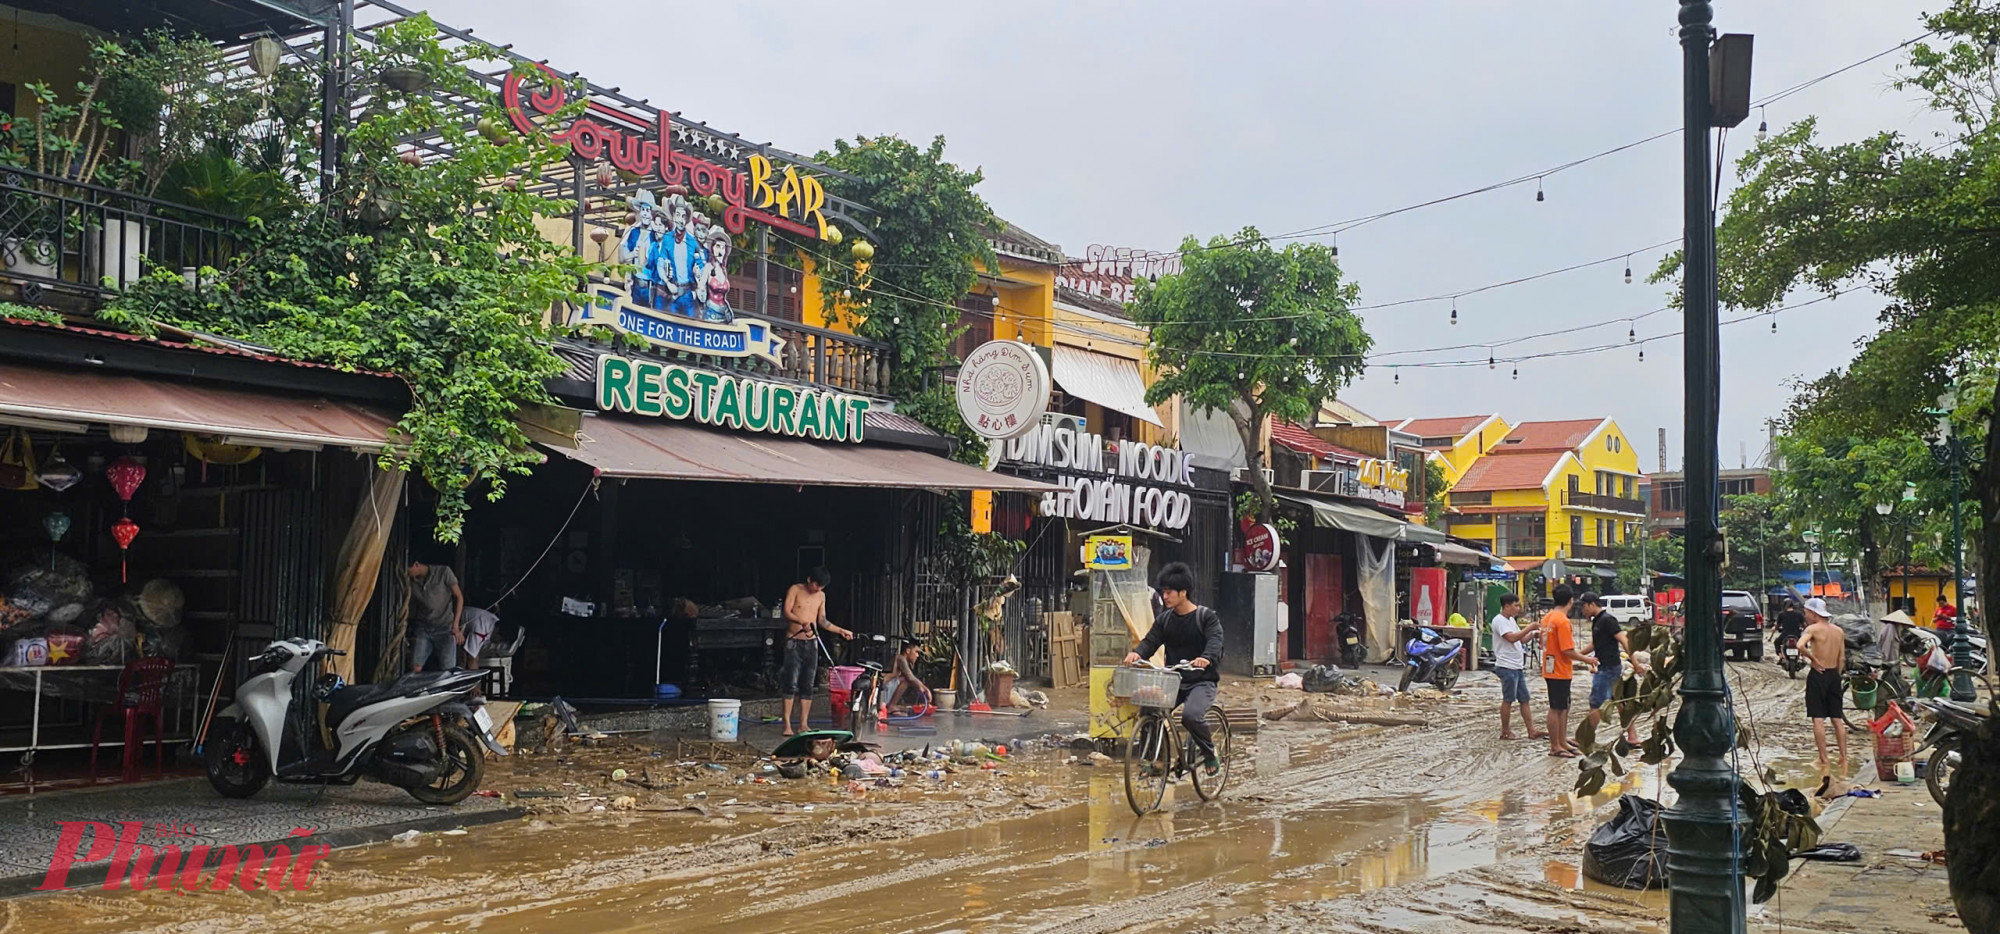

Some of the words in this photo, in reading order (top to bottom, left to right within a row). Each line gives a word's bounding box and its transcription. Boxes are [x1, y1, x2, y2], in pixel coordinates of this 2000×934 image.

[501, 61, 817, 236] Cowboy
[747, 154, 829, 242] BAR
[1082, 244, 1186, 282] SAFFRO
[618, 311, 644, 334] ONE
[648, 321, 673, 341] FOR
[677, 328, 701, 346] THE
[704, 333, 742, 349] ROAD!
[598, 355, 870, 443] RESTAURANT
[1118, 439, 1196, 488] NOODLE
[1132, 486, 1191, 530] FOOD
